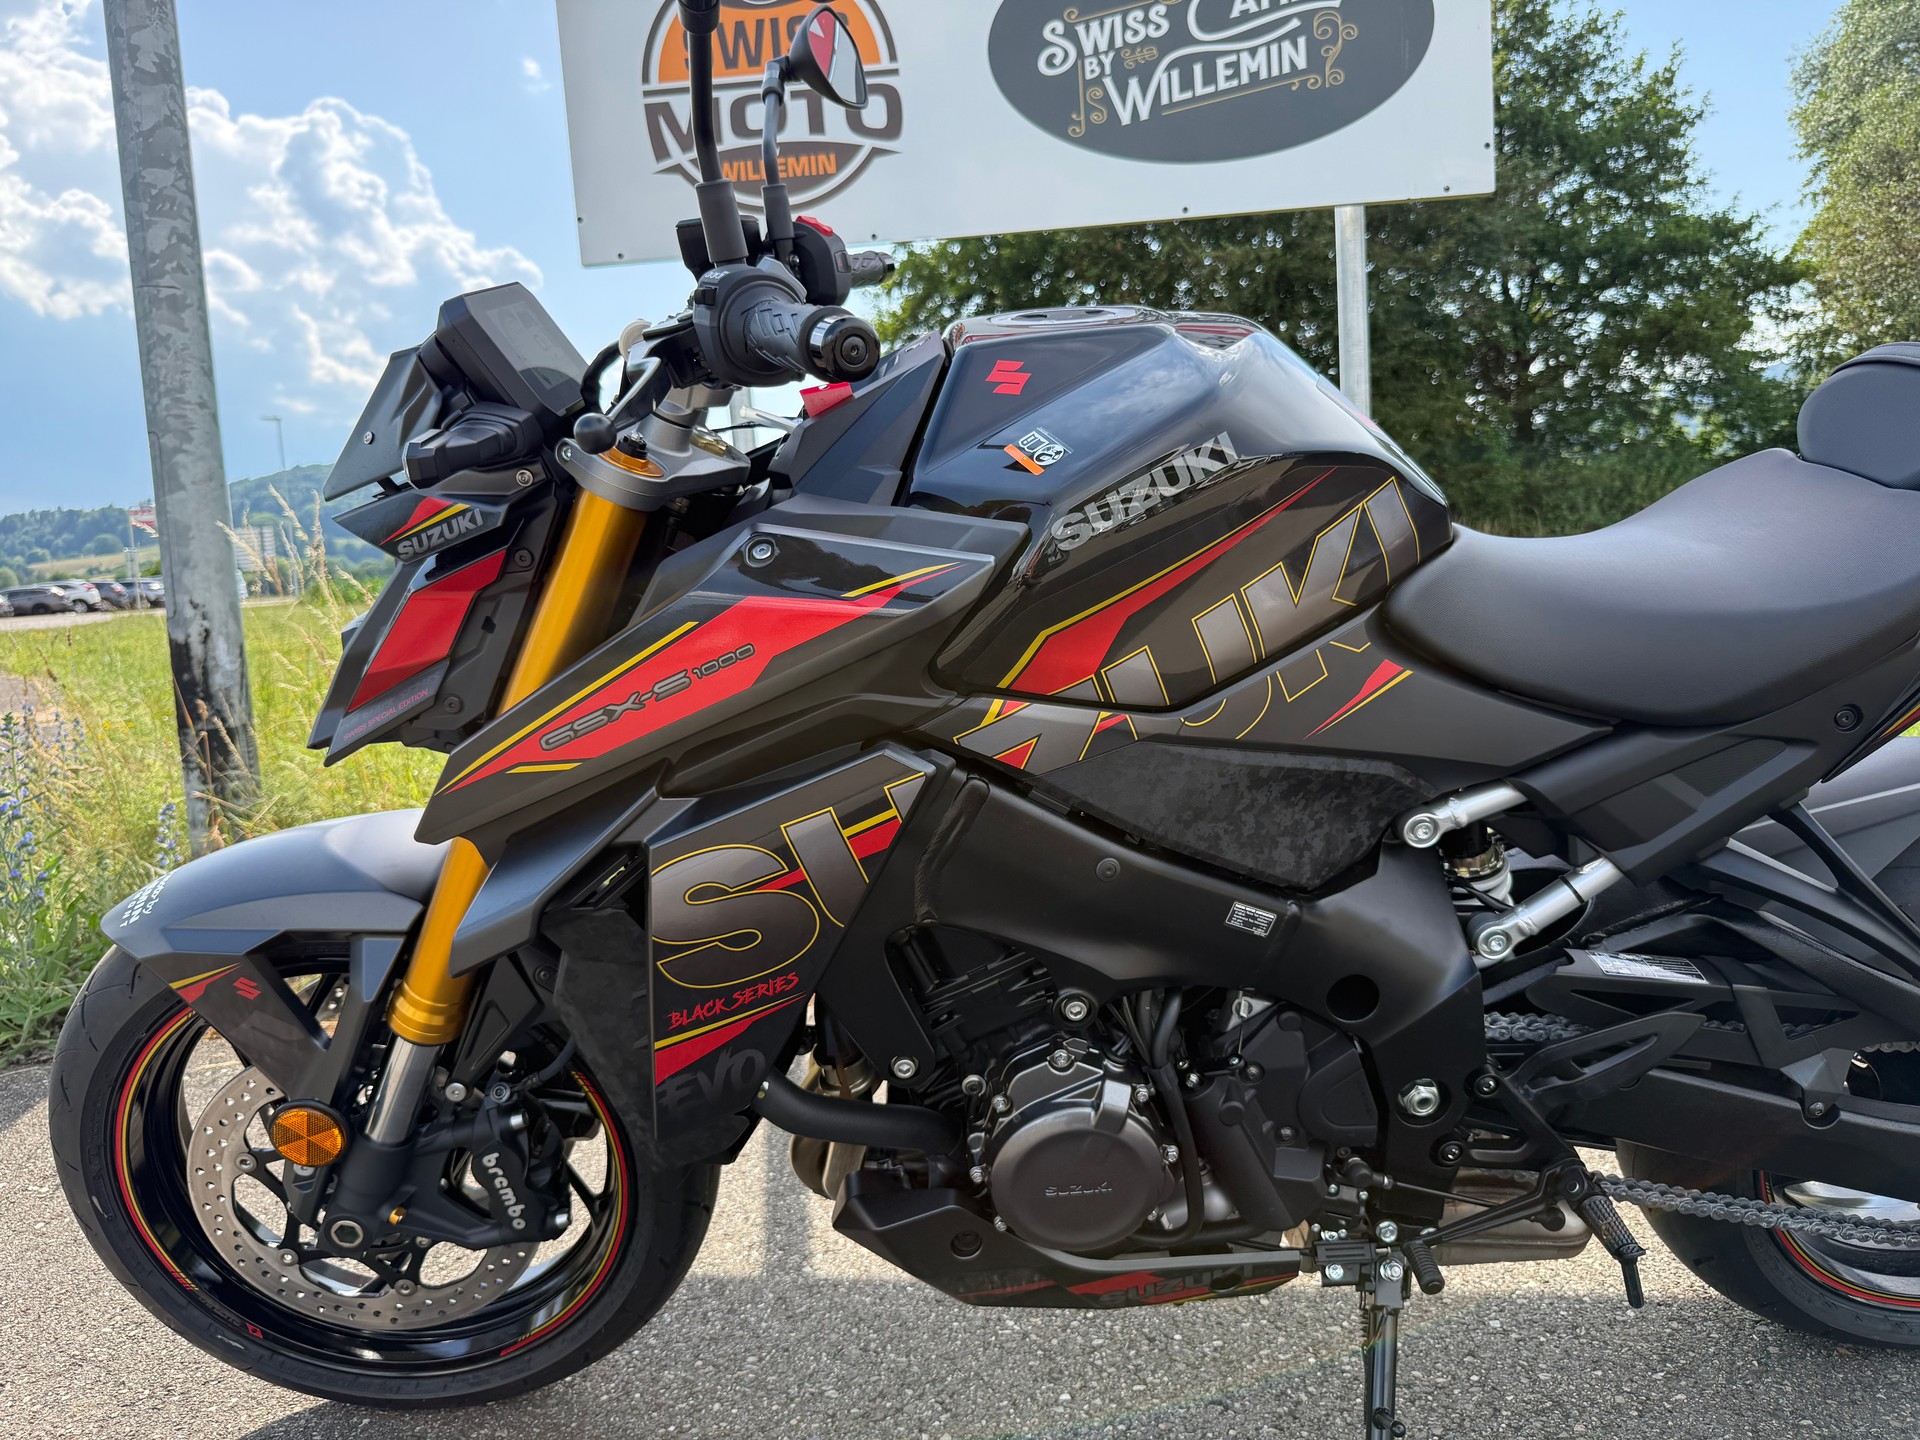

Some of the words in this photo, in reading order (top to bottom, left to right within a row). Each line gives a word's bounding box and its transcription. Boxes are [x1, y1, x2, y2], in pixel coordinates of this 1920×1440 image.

[1037, 4, 1170, 76] SWISS
[1083, 50, 1116, 81] BY
[1101, 18, 1308, 126] WILLEMIN
[643, 83, 903, 164] MOTO
[1051, 431, 1240, 551] SUZUKI
[397, 508, 484, 560] SUZUKI
[343, 724, 368, 741] SWISS
[367, 707, 398, 728] SPECIAL
[398, 689, 430, 709] EDITION
[667, 995, 735, 1031] BLACK
[731, 971, 800, 1009] SERIES
[655, 1046, 767, 1108] EVO
[482, 1152, 527, 1230] brembo
